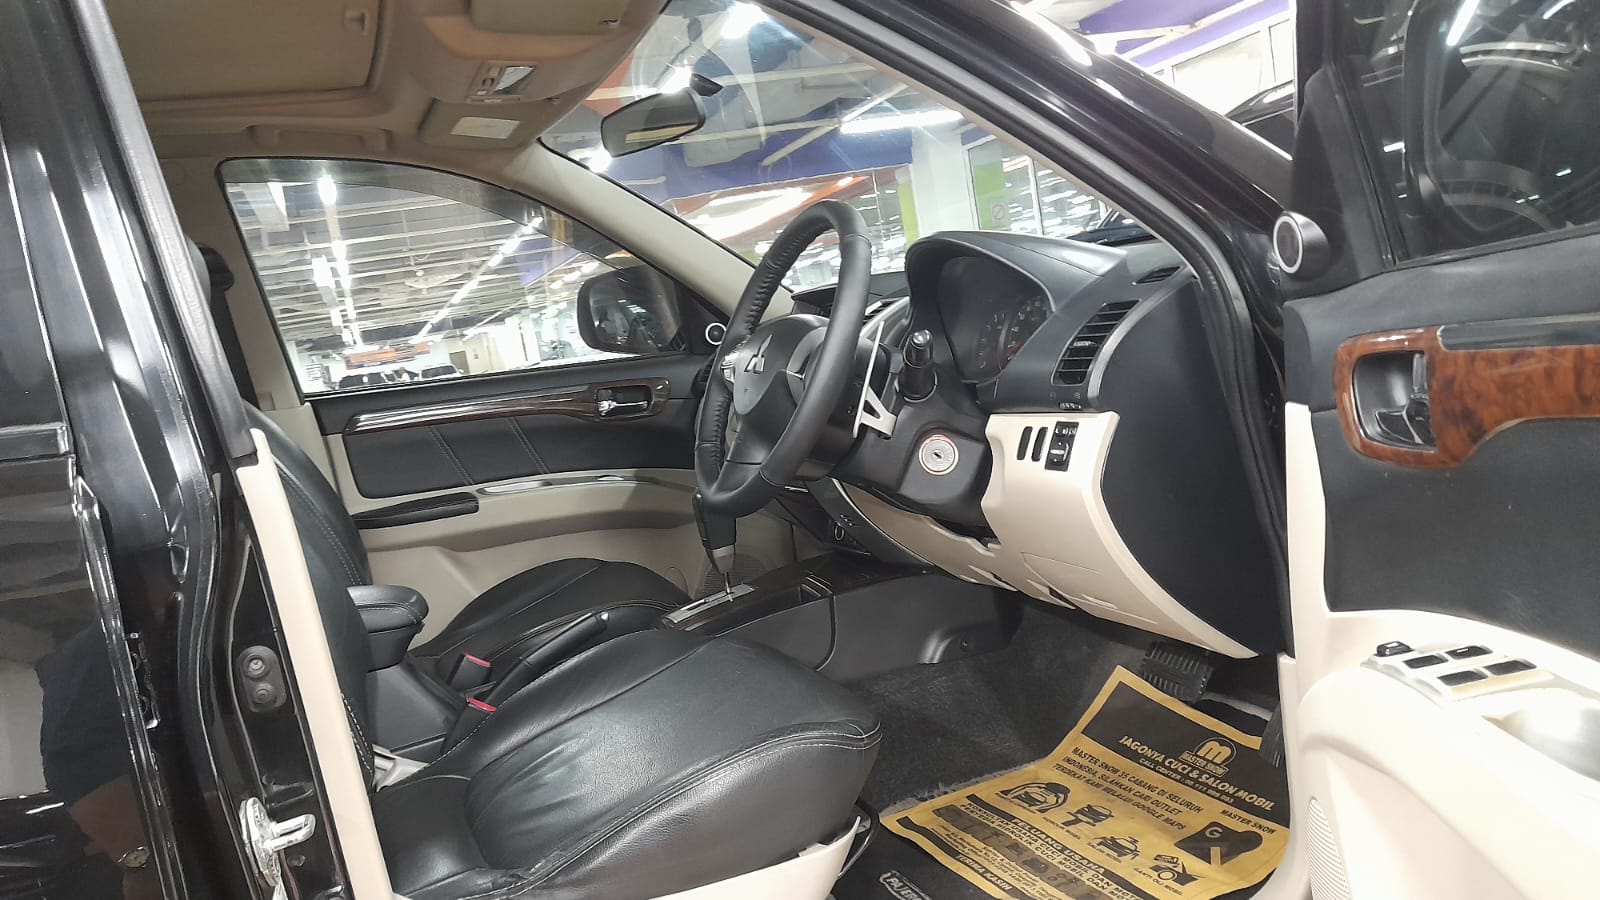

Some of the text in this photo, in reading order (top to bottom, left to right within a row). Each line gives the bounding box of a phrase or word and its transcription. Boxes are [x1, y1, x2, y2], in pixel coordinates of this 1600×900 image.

[1072, 746, 1204, 814] MASTER SNOW 35 CABANG DI SELURUH
[1119, 735, 1276, 811] JAGONYA CUCI & SALON MOBIL
[1139, 758, 1154, 769] CALL
[1155, 765, 1182, 781] CENTER
[1053, 763, 1087, 780] TERDEKAT
[1101, 786, 1134, 803] MELALUI
[1131, 801, 1164, 819] GOOGLE
[1162, 817, 1186, 831] MAPS
[1098, 773, 1135, 793] SILAHKAN
[1132, 791, 1152, 802] CARI
[1150, 799, 1182, 815] OUTLET
[1011, 818, 1063, 850] PELUANG
[1204, 826, 1224, 839] G
[1220, 809, 1277, 834] MASTER SNOW
[955, 854, 1012, 891] TERIMA KASIH
[996, 823, 1035, 846] HIDROLIK
[1035, 845, 1057, 861] CUCI
[1057, 860, 1085, 878] MOBIL
[1086, 877, 1108, 891] DAN
[1040, 842, 1061, 858] CUCI
[1061, 856, 1089, 874] MOBIL
[1091, 872, 1113, 887] DAN
